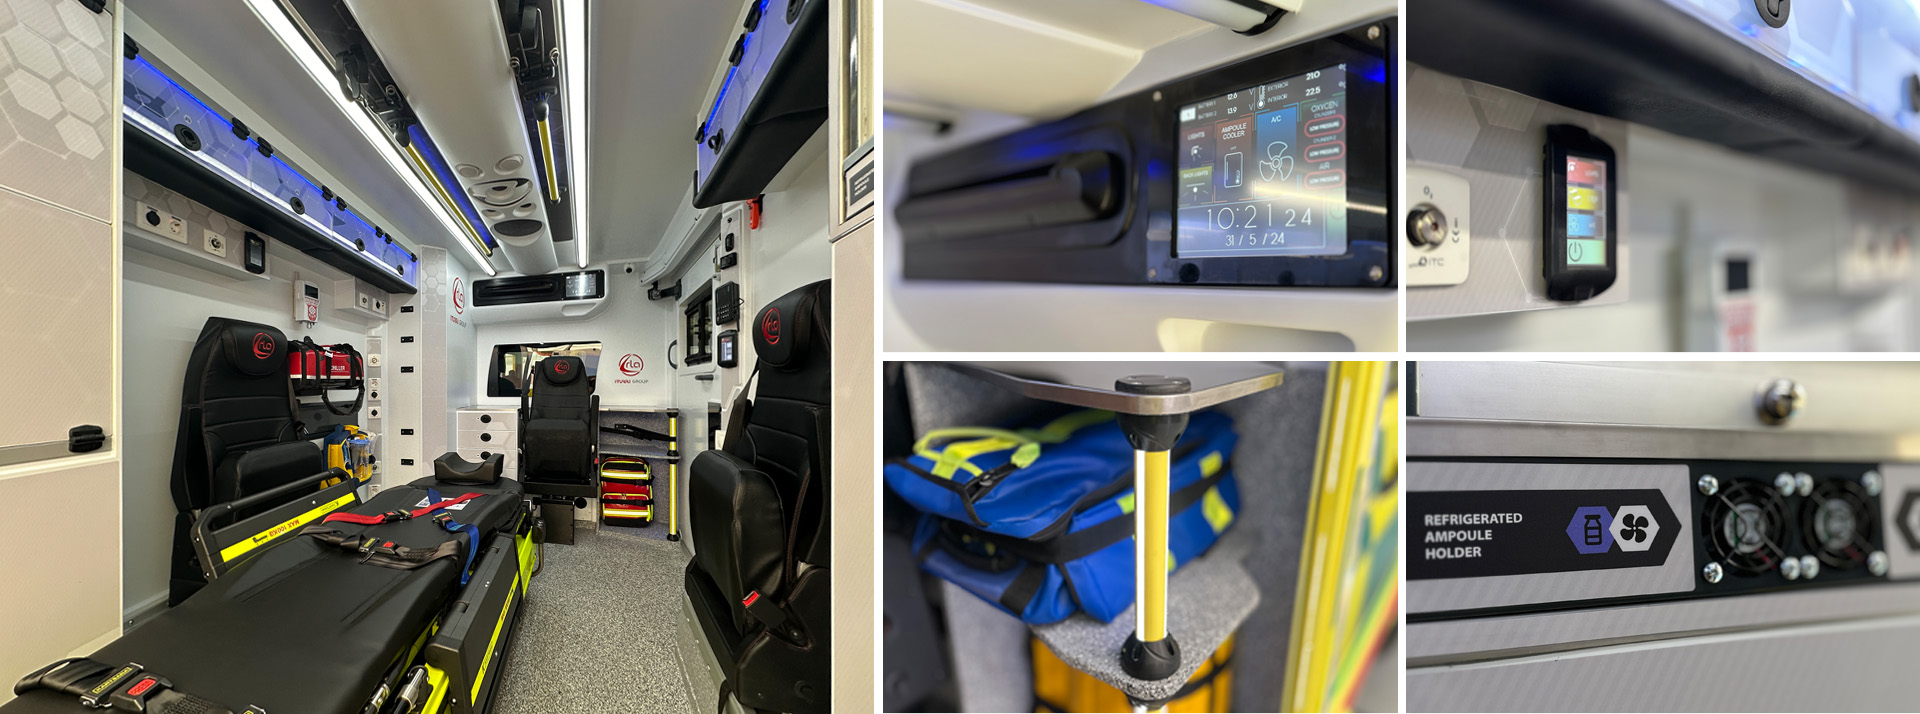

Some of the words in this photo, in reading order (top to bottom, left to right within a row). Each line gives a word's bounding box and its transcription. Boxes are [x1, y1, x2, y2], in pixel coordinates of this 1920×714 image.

[1306, 86, 1320, 96] 22.5
[1311, 101, 1338, 112] OXYGEN
[1271, 115, 1281, 123] A/C
[1222, 123, 1246, 133] AMPOULE
[1223, 130, 1245, 139] COOLER
[288, 519, 299, 529] MAX
[1425, 513, 1523, 527] REFRIGERATED
[1425, 530, 1492, 543] AMPOULE
[1425, 546, 1482, 560] HOLDER
